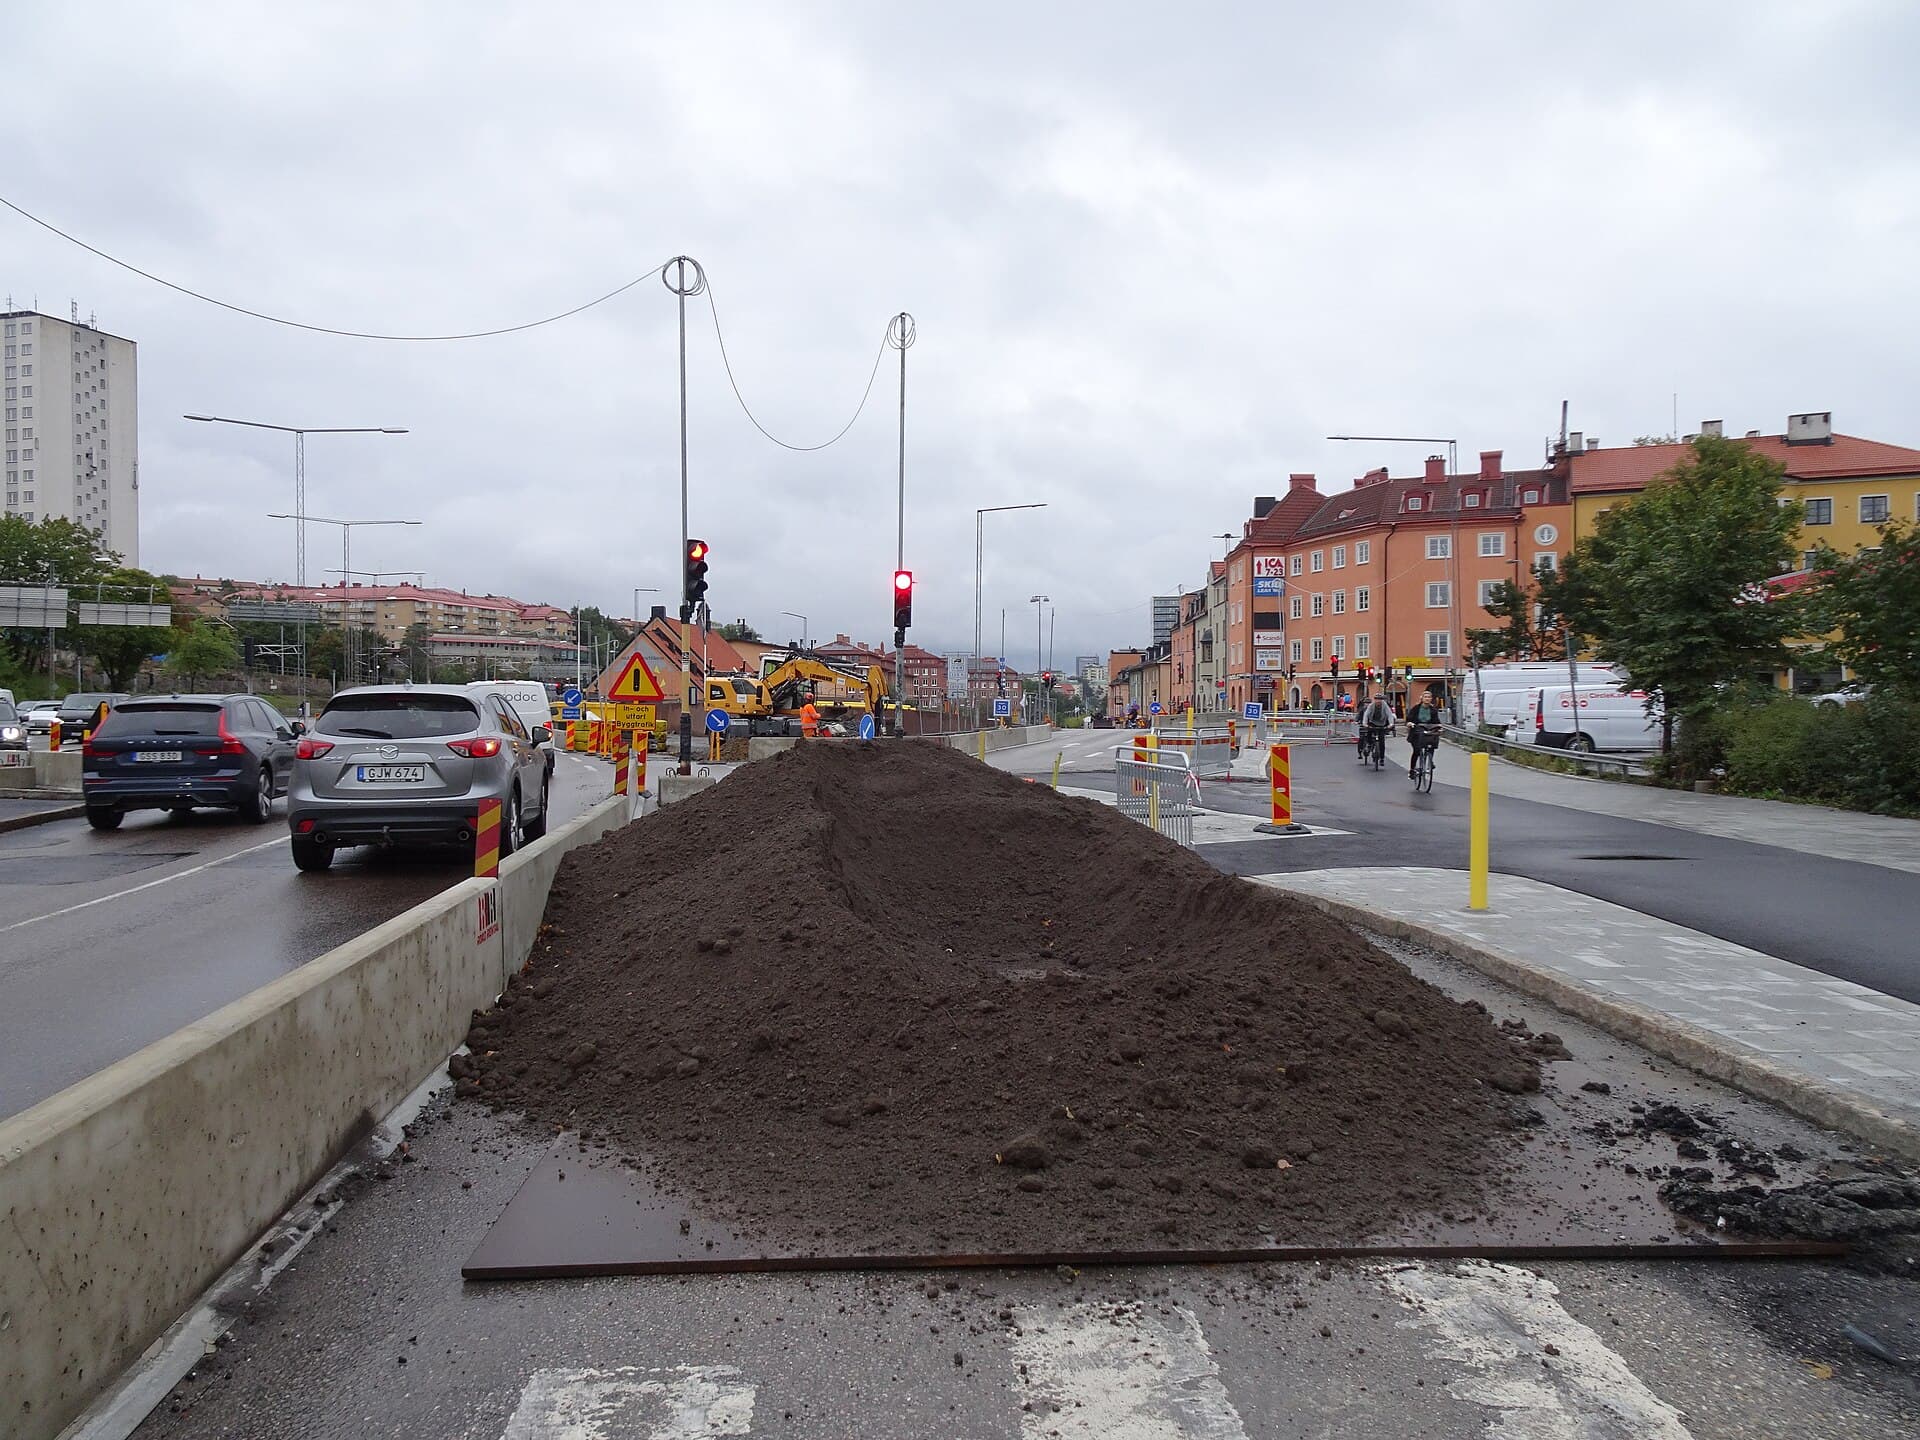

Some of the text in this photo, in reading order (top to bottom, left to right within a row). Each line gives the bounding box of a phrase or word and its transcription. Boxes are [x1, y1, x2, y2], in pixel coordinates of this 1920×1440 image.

[1265, 558, 1284, 568] ICA
[616, 720, 654, 728] Byggtrafik
[368, 768, 418, 778] GJW 674
